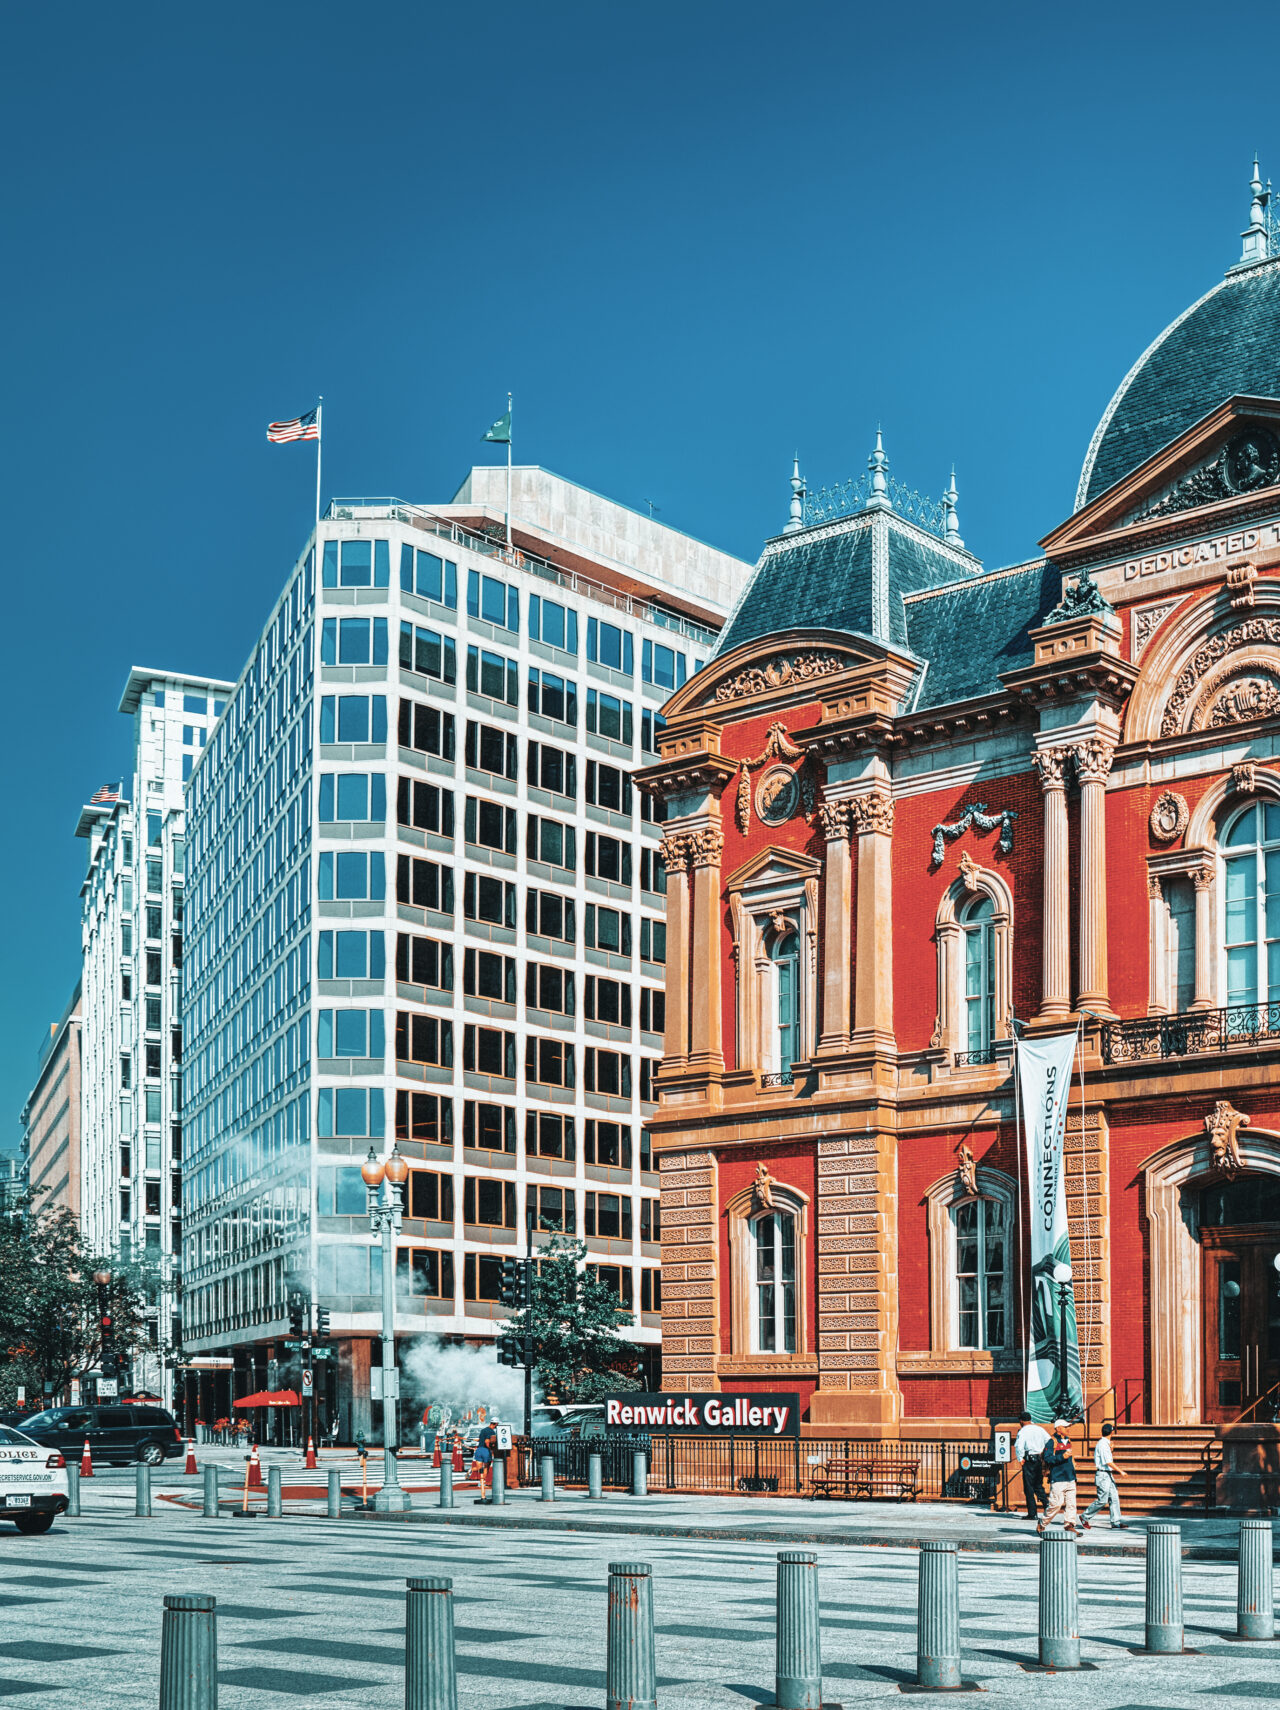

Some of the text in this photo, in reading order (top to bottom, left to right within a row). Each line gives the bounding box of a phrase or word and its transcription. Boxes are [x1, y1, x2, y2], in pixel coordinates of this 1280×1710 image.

[1124, 530, 1260, 581] DEDICATED
[1043, 1065, 1057, 1232] CONNECTIONS
[607, 1398, 789, 1435] Renwick Gallery
